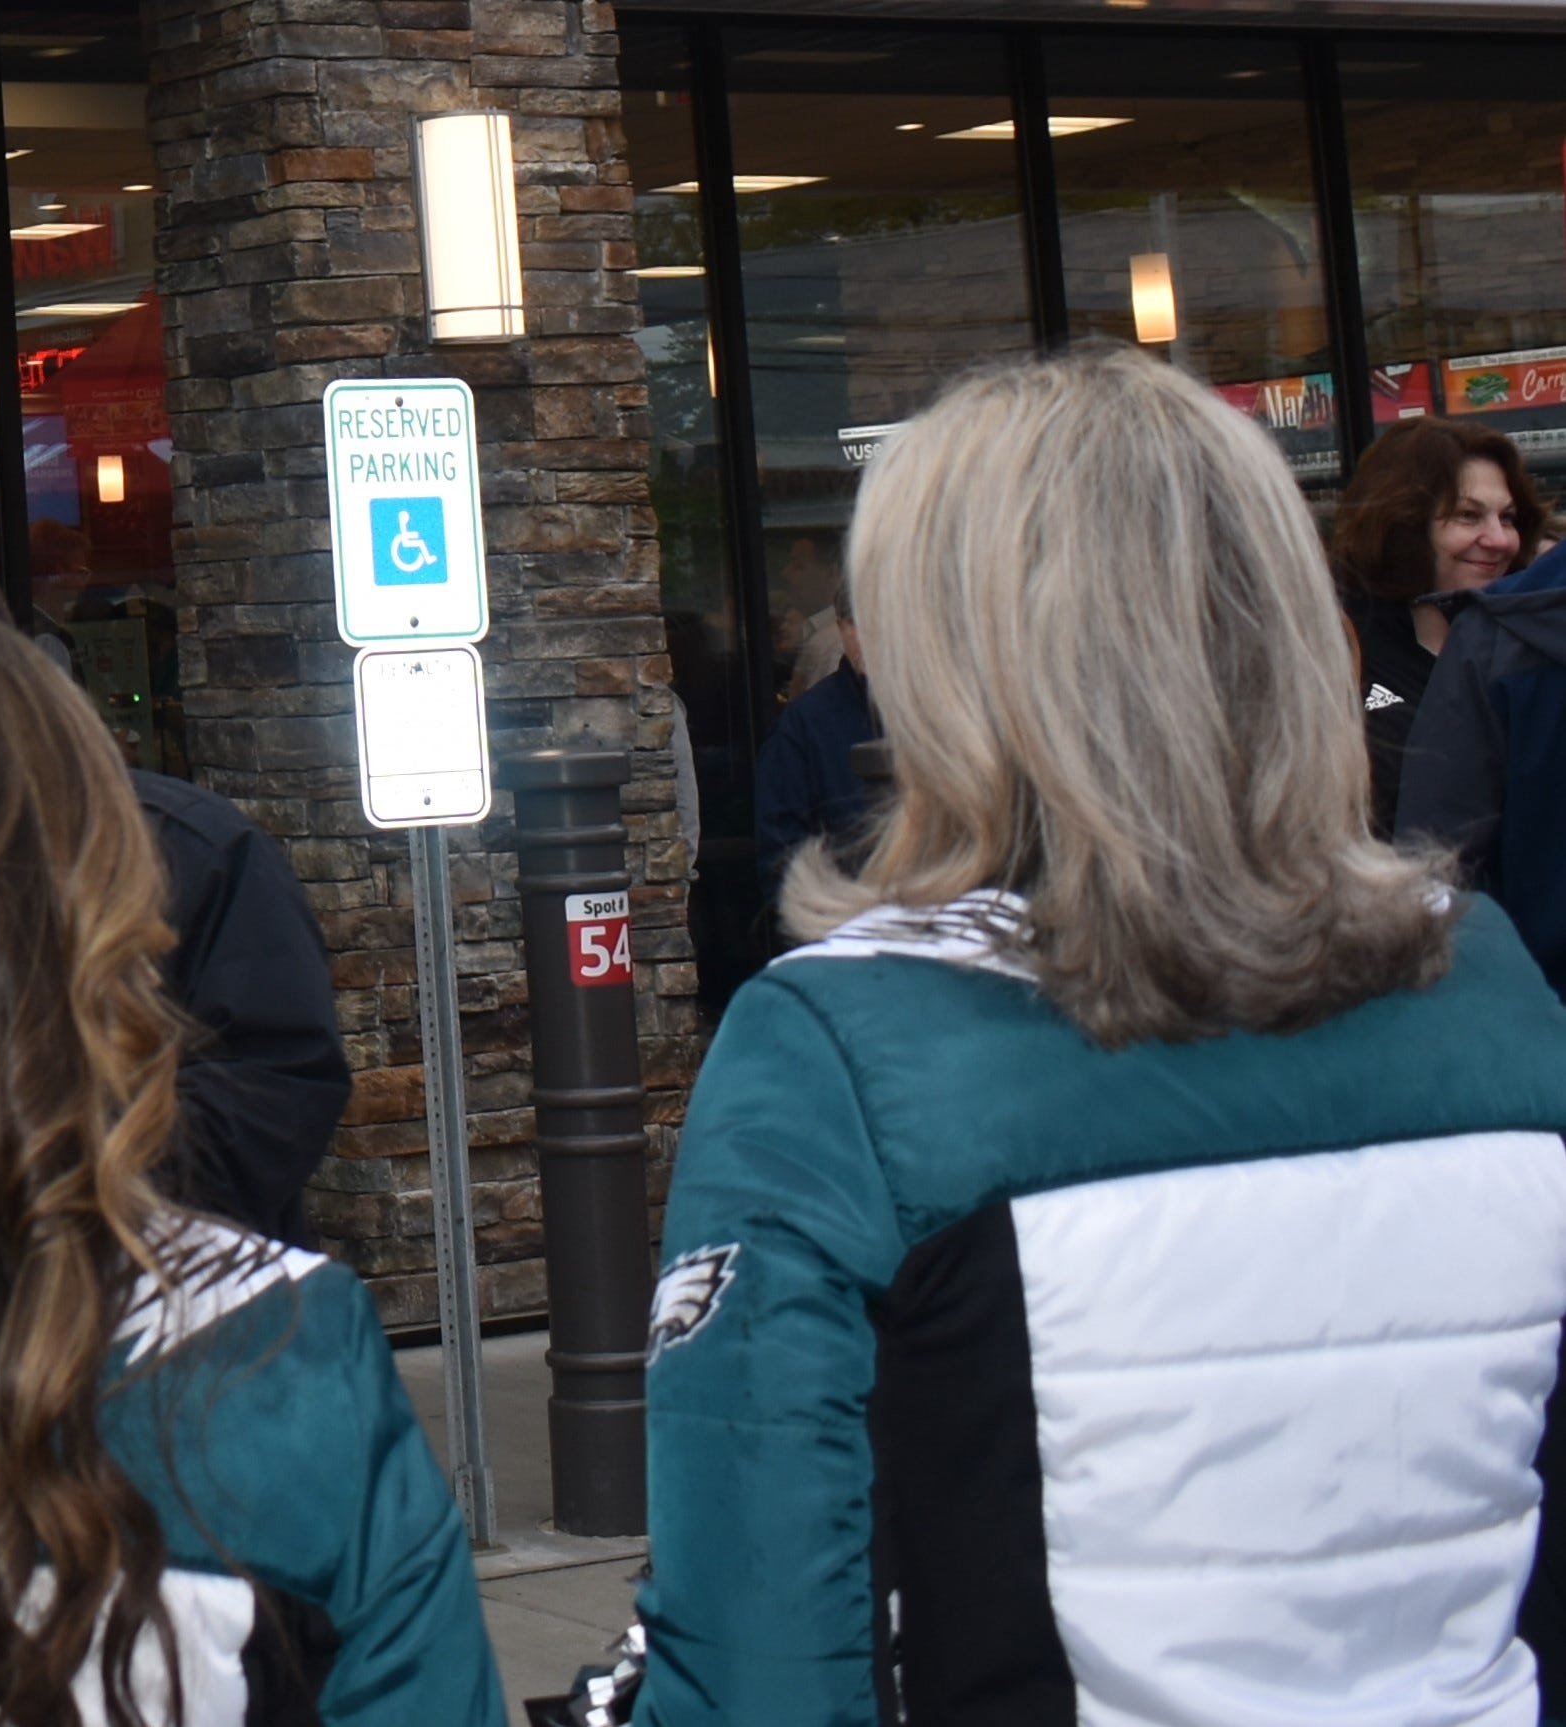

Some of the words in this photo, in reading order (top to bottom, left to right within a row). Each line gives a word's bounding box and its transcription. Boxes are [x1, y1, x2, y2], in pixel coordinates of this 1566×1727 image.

[1264, 383, 1335, 430] Marlb
[338, 407, 461, 439] RESERVED
[350, 452, 457, 483] PARKING
[583, 898, 616, 918] Spot
[580, 922, 631, 978] 54
